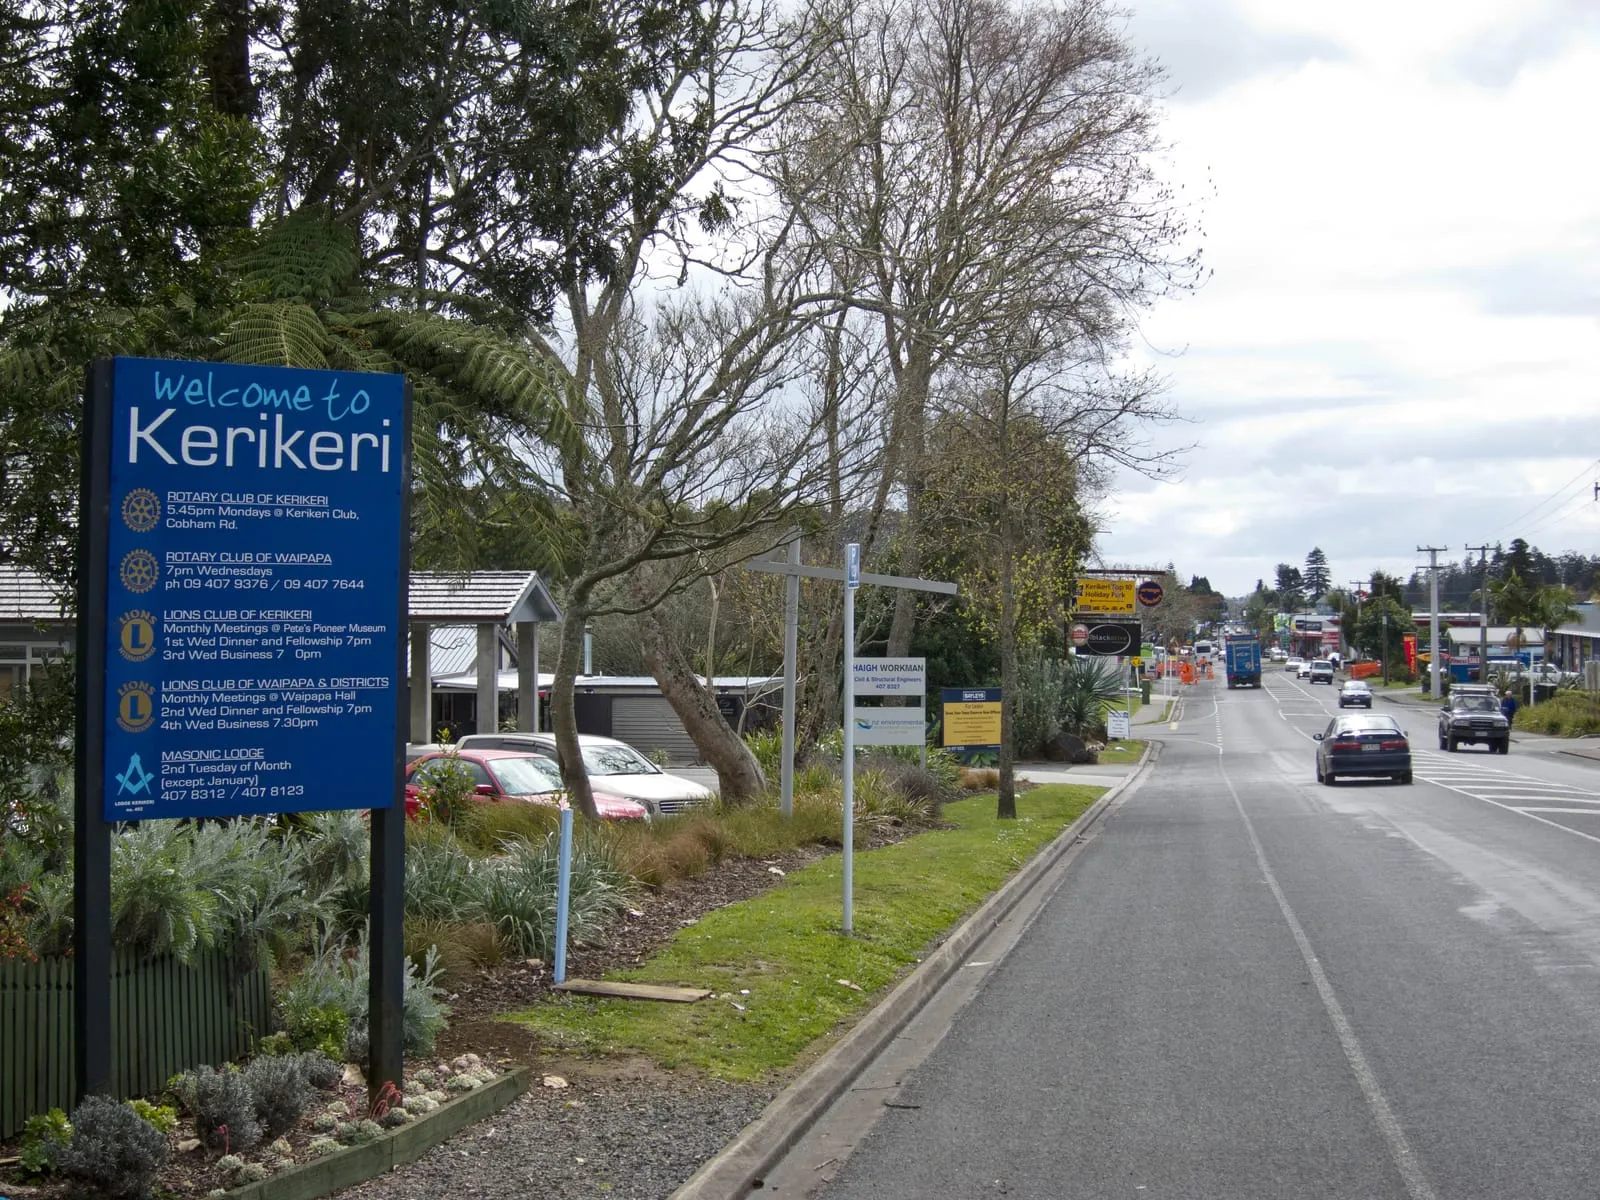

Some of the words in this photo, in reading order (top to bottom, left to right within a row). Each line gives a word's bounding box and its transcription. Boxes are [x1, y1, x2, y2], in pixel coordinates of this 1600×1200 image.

[154, 371, 314, 411] Welcome
[321, 378, 370, 421] to
[128, 406, 390, 472] Kerikeri
[167, 491, 217, 503] ROTARY
[221, 492, 254, 504] CLUB
[257, 494, 273, 504] OF
[276, 495, 329, 505] KERIKERI
[167, 505, 215, 518] 5.45pm
[218, 506, 271, 520] Mondays
[273, 509, 283, 518] @
[286, 508, 330, 519] Kerikeri
[332, 509, 360, 521] Club,
[166, 518, 216, 529] Cobham
[219, 519, 238, 530] Rd.
[166, 552, 217, 563] ROTARY
[220, 552, 253, 563] CLUB
[256, 553, 273, 563] OF
[275, 553, 332, 564] WAIPAPA
[166, 565, 193, 577] 7pm
[196, 565, 273, 578] Wednesdays
[165, 578, 180, 590] ph
[183, 579, 201, 589] 09
[204, 579, 231, 589] 407
[234, 579, 268, 590] 9376
[284, 579, 301, 589] 09
[303, 579, 329, 590] 407
[332, 579, 364, 590] 7644
[119, 609, 157, 625] LIONS
[164, 610, 201, 620] LIONS
[203, 610, 237, 620] CLUB
[240, 610, 257, 620] OF
[259, 610, 312, 620] KERIKERI
[163, 623, 211, 635] Monthly
[214, 623, 268, 635] Meetings
[271, 624, 281, 633] @
[284, 624, 311, 633] Pete's
[313, 624, 346, 633] Pioneer
[348, 624, 386, 633] Museum
[165, 637, 184, 647] 1st
[187, 636, 216, 647] Wed
[219, 637, 258, 646] Dinner
[261, 636, 283, 646] and
[286, 636, 343, 648] Fellowship
[346, 636, 371, 647] 7pm
[163, 650, 185, 660] 3rd
[187, 649, 217, 660] Wed
[220, 650, 273, 660] Business
[853, 664, 878, 672] HAIGH
[880, 664, 924, 672] WORKMAN
[117, 681, 157, 697] LIONS
[162, 680, 199, 690] LIONS
[201, 680, 235, 690] CLUB
[238, 679, 255, 689] OF
[257, 678, 315, 689] WAIPAPA
[318, 678, 327, 688] &
[330, 677, 389, 688] DISTRICTS
[161, 693, 208, 705] Monthly
[212, 693, 266, 705] Meetings
[269, 692, 279, 702] @
[281, 692, 332, 703] Waipapa
[335, 691, 356, 701] Hall
[161, 707, 185, 717] 2nd
[188, 706, 217, 716] Wed
[220, 706, 259, 716] Dinner
[262, 705, 283, 715] and
[286, 704, 343, 716] Fellowship
[347, 704, 372, 715] 7pm
[161, 720, 181, 730] 4th
[185, 719, 213, 730] Wed
[217, 719, 269, 730] Business
[273, 718, 318, 730] 7.30pm
[162, 750, 222, 761] MASONIC
[224, 748, 264, 759] LODGE
[161, 764, 185, 774] 2nd
[188, 762, 237, 775] Tuesday
[239, 762, 252, 772] of
[254, 761, 292, 771] Month
[161, 778, 204, 790] (except
[207, 775, 259, 787] January)
[161, 790, 187, 801] 407
[191, 789, 225, 800] 8312
[241, 786, 266, 797] 407
[270, 785, 304, 796] 8123
